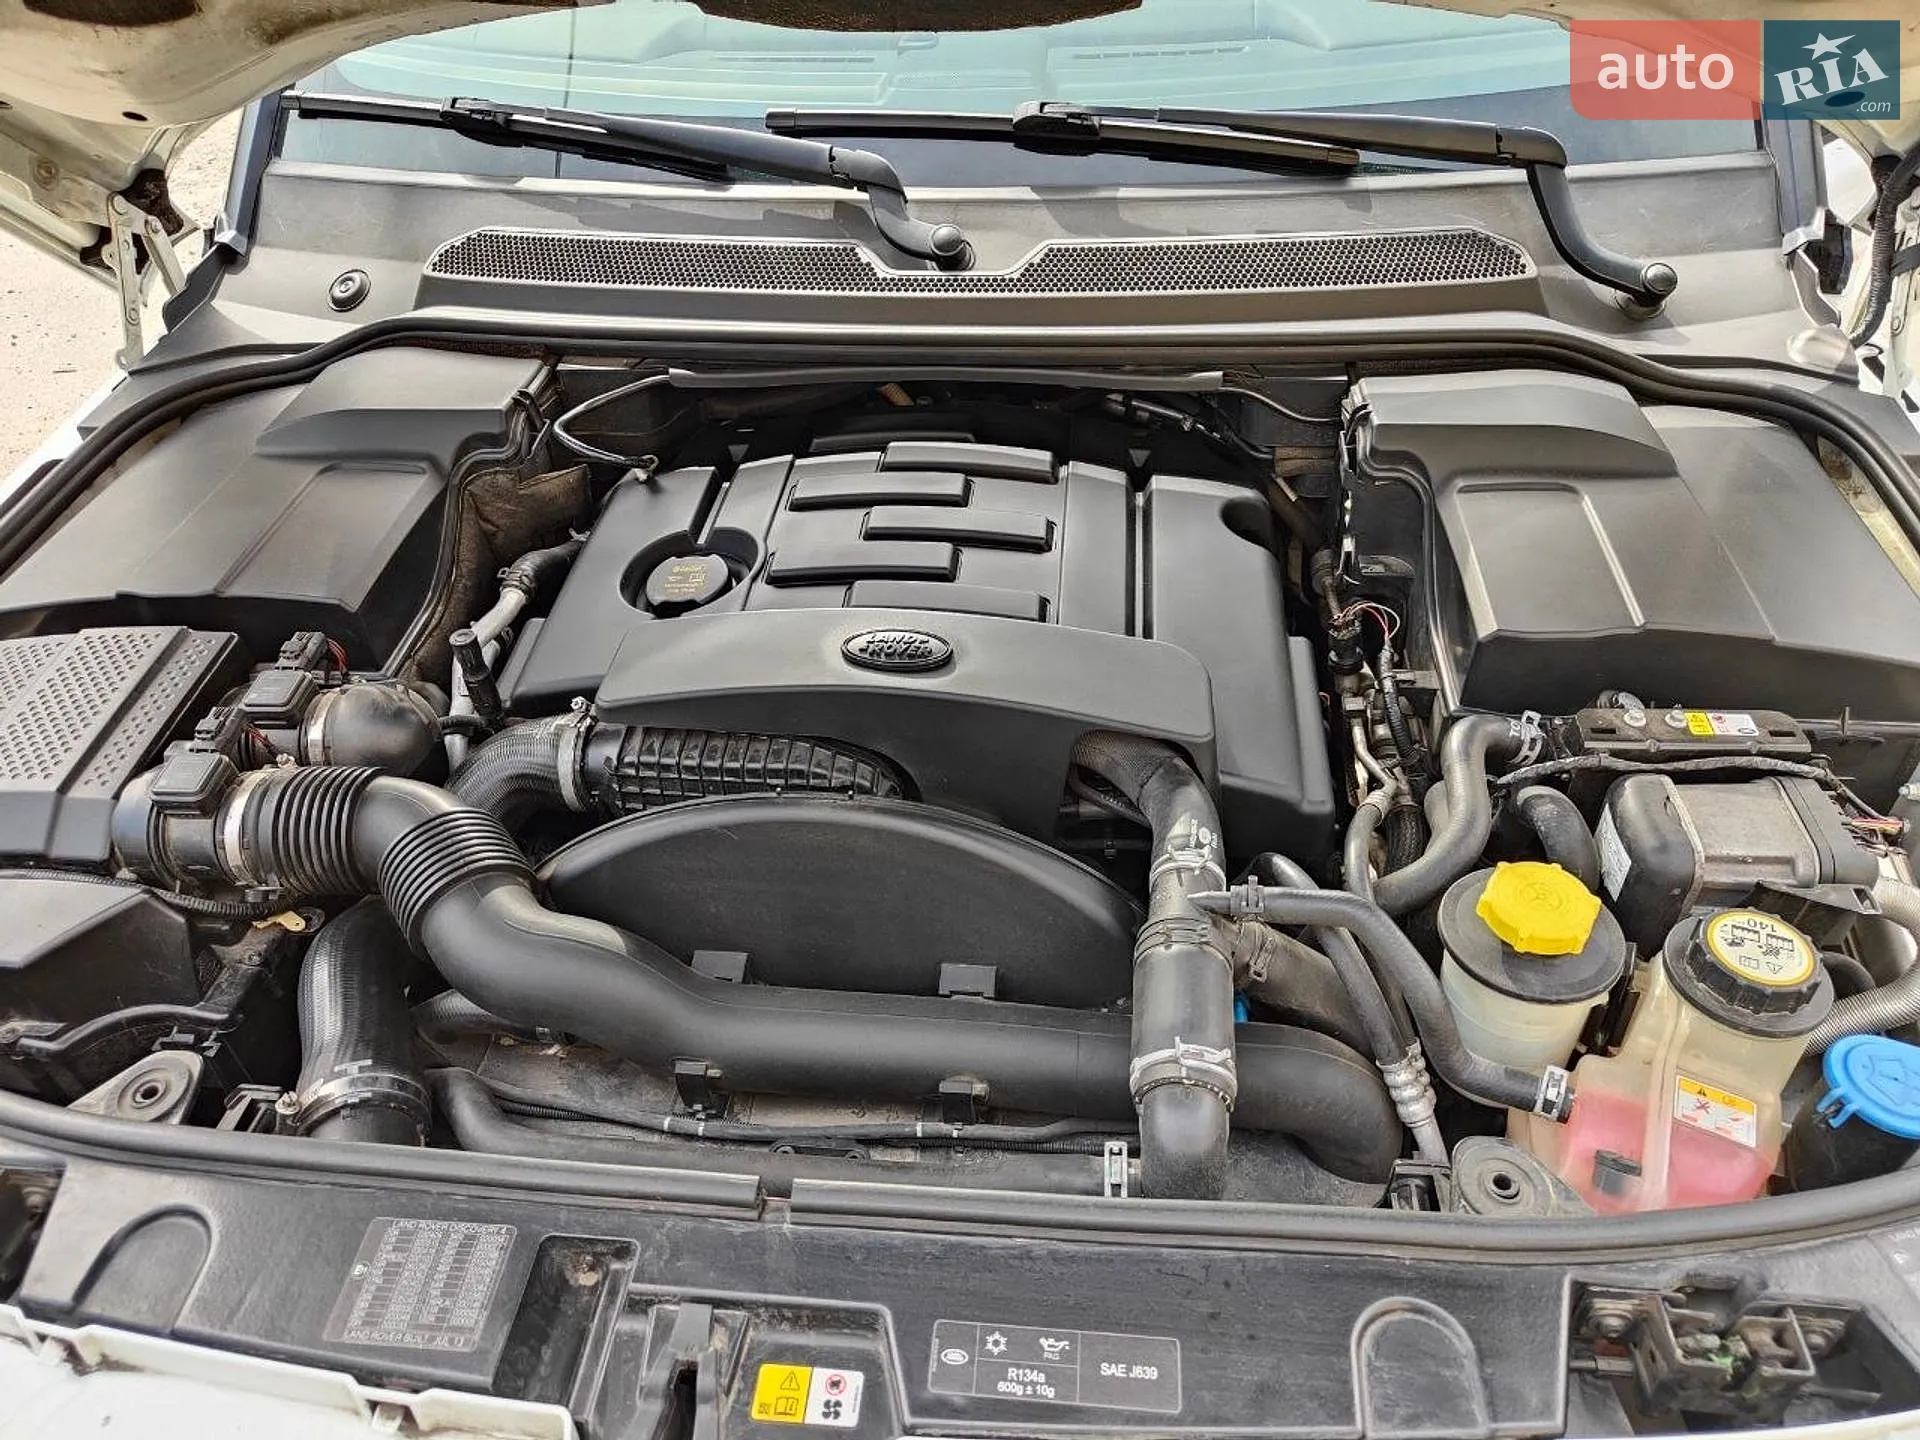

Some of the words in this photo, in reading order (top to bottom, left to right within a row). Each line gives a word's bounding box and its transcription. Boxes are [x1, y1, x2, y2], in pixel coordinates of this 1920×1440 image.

[866, 633, 918, 645] LAND
[867, 643, 934, 658] ROVER
[1007, 1367, 1046, 1383] R134a
[1100, 1362, 1127, 1377] SAE
[1128, 1364, 1158, 1380] J639
[997, 1381, 1024, 1396] 600g
[1035, 1384, 1055, 1398] 10g
